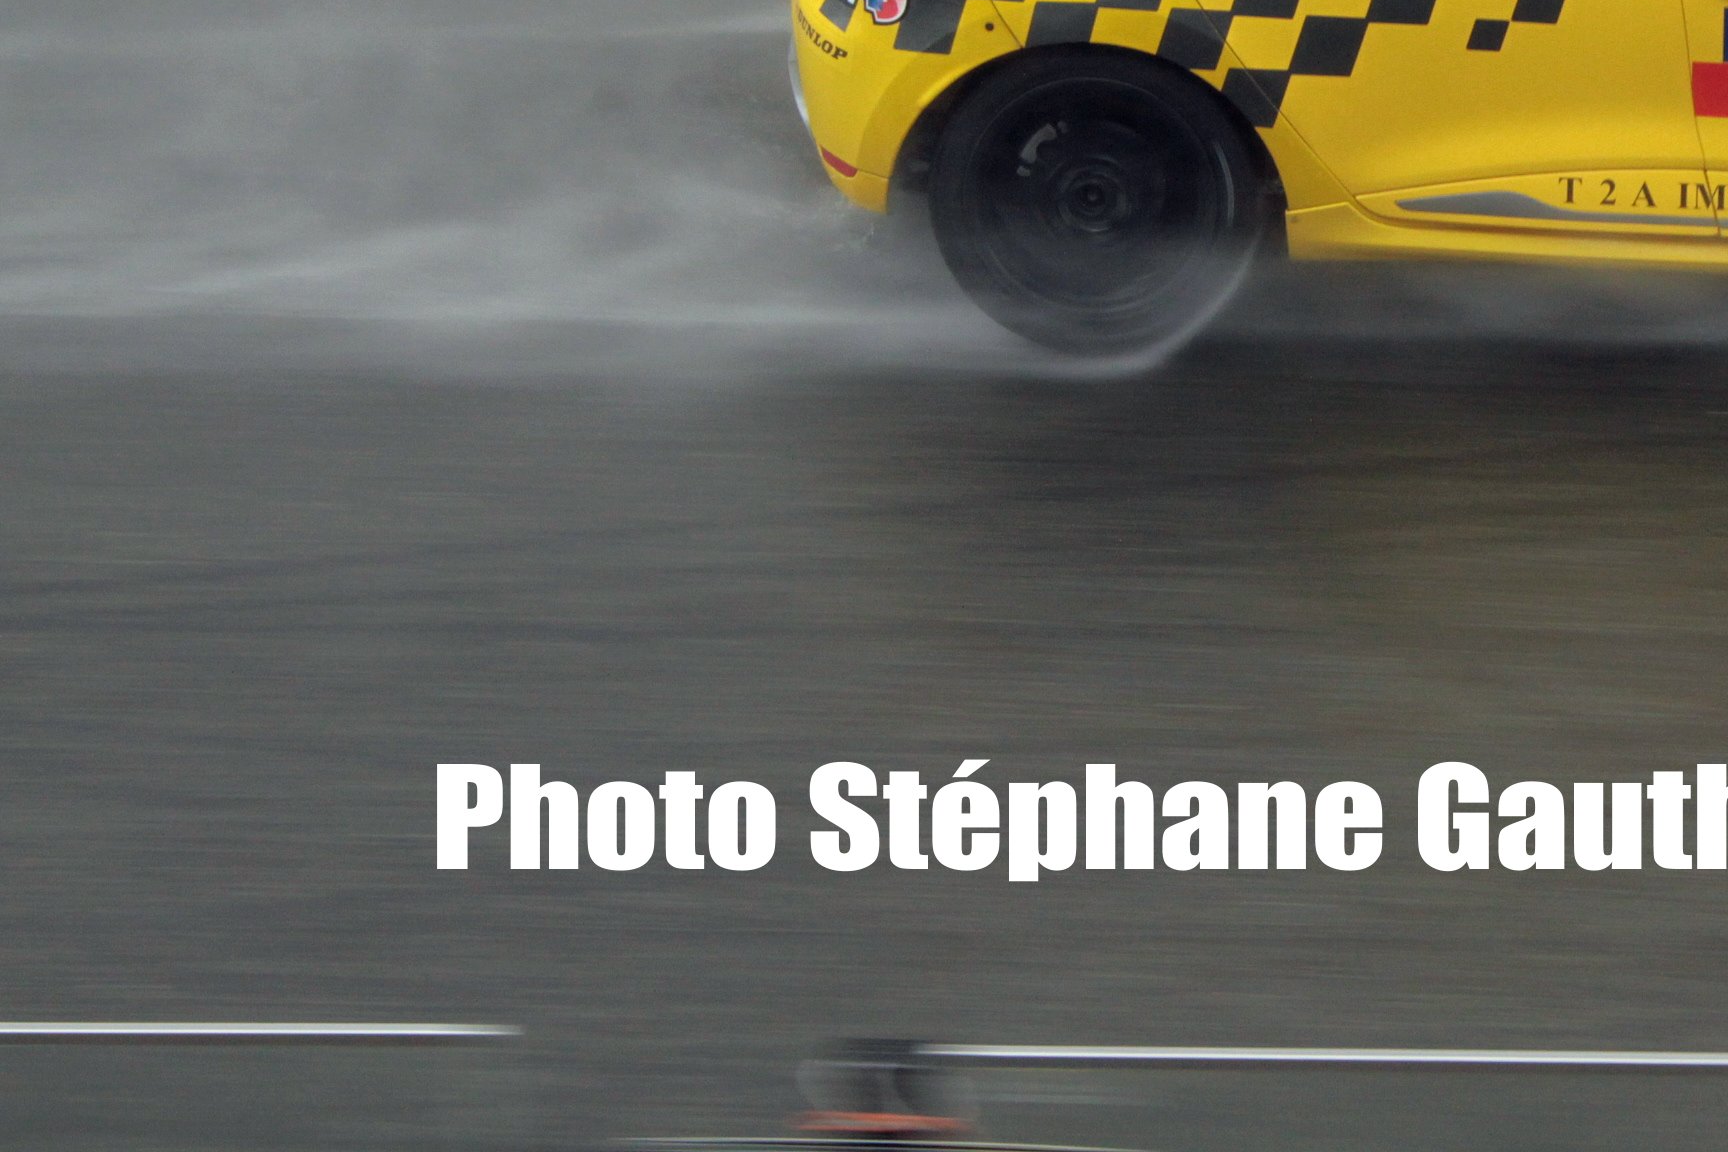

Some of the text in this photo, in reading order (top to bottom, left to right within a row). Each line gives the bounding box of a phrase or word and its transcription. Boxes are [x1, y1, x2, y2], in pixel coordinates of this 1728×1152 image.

[1558, 177, 1583, 204] T
[1600, 179, 1617, 206] 2
[1631, 181, 1658, 208] A
